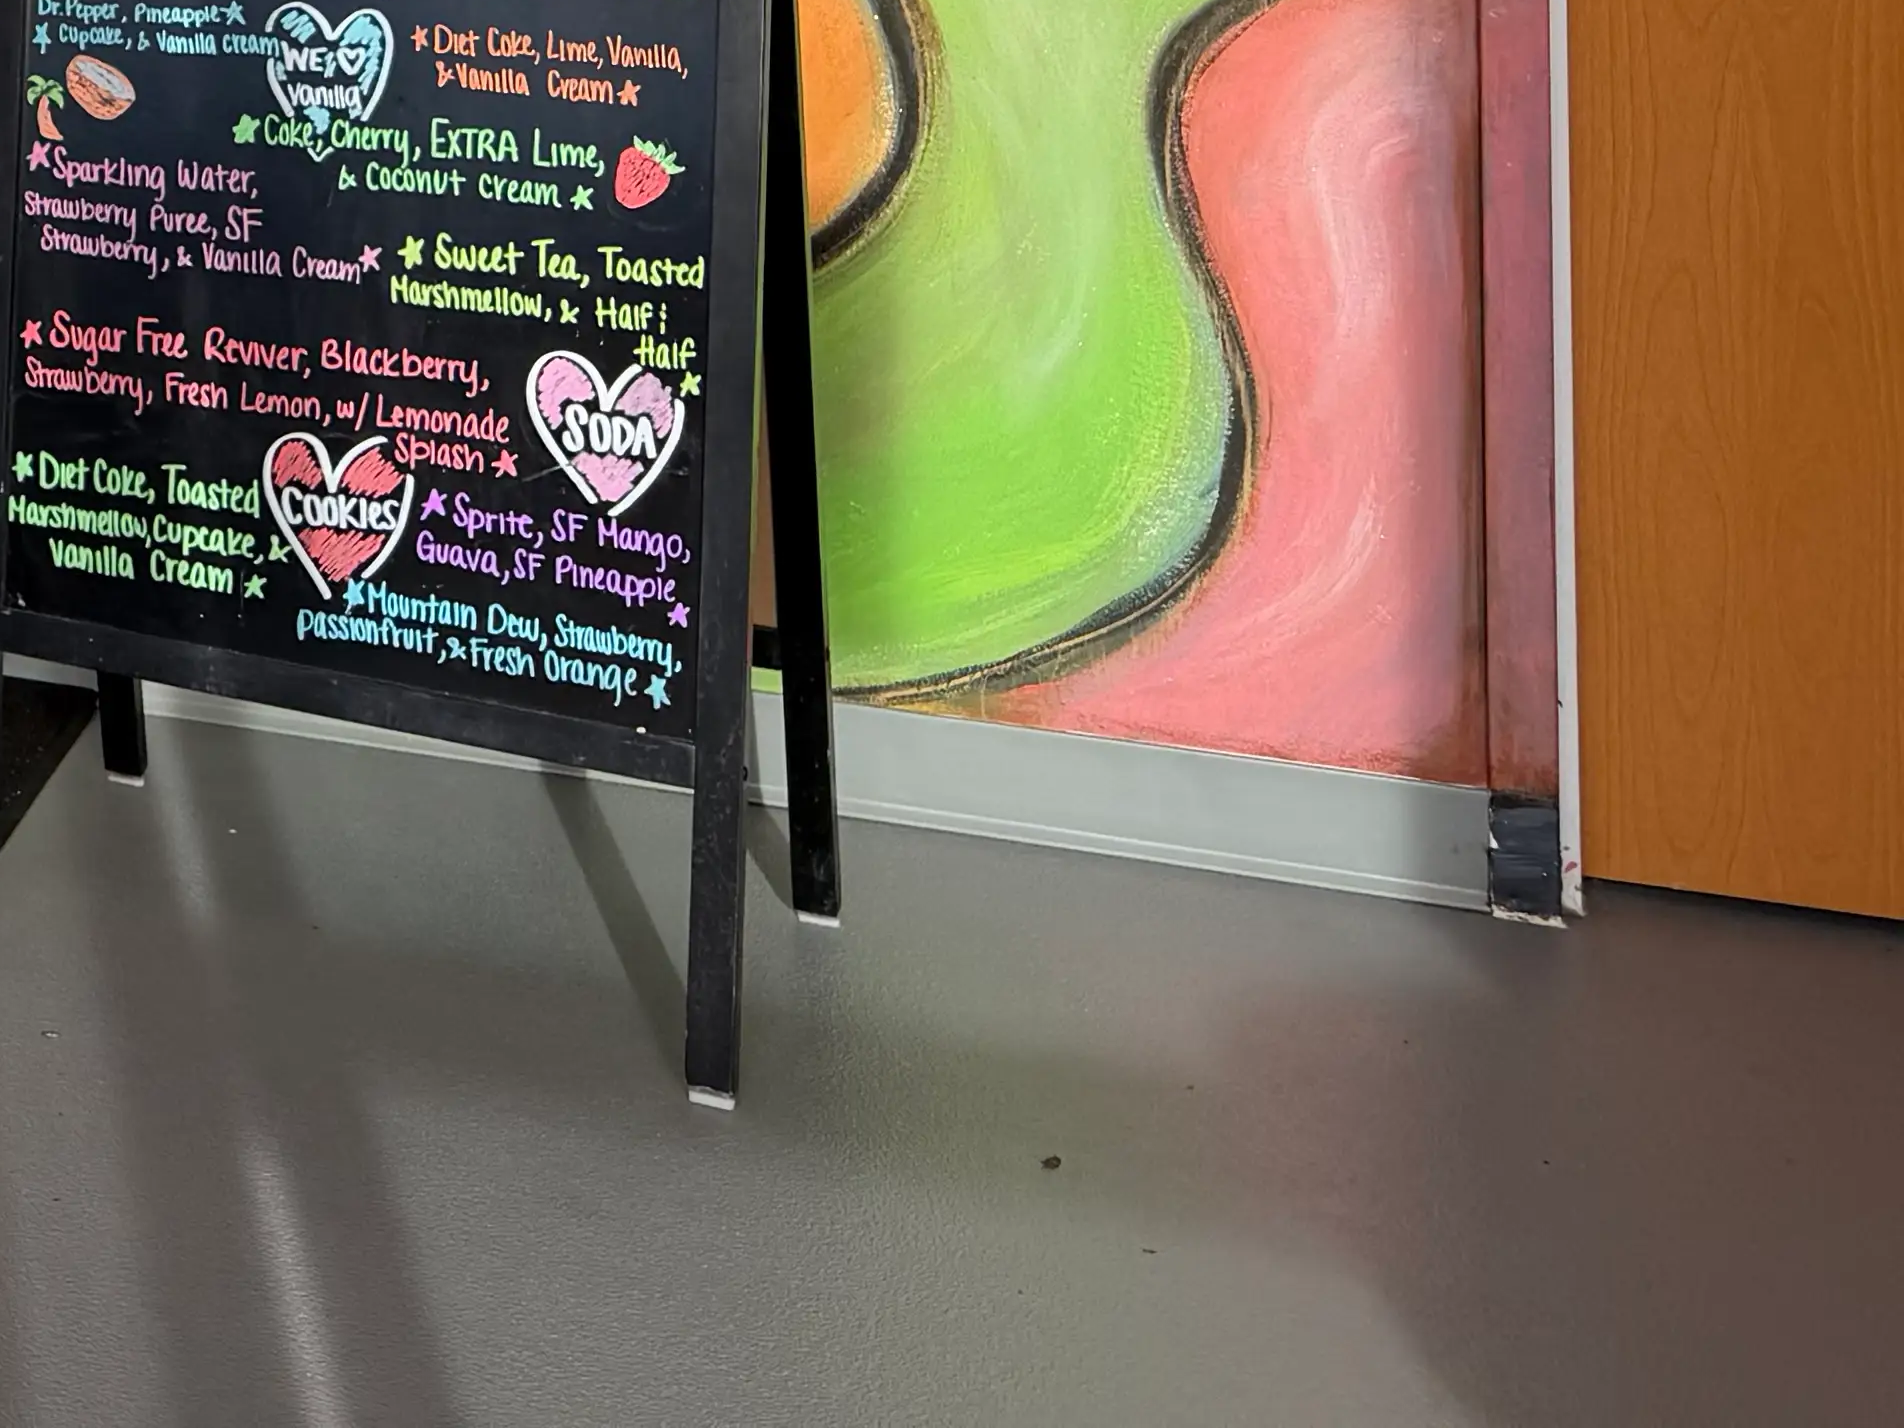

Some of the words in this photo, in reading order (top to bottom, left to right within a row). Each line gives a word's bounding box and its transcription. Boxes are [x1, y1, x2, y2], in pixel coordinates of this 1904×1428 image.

[134, 2, 220, 28] Pineapple
[138, 31, 150, 51] &
[156, 30, 217, 56] Vanilla
[434, 24, 478, 56] Diet
[487, 27, 539, 65] Coke,
[547, 30, 603, 70] Lime,
[607, 36, 688, 79] Vanilla,
[456, 64, 529, 97] Vanilla
[547, 70, 613, 105] Cream
[53, 145, 165, 202] Sparkling
[178, 158, 259, 199] Water,
[331, 116, 420, 170] Cherry,
[532, 127, 604, 178] Lime,
[339, 164, 357, 190] &
[24, 191, 137, 241] Strawberry
[149, 204, 218, 241] Puree,
[225, 205, 263, 243] SF
[40, 223, 169, 280] Strawberry,
[177, 246, 193, 267] &
[202, 243, 282, 277] Vanilla
[292, 246, 360, 284] Cream
[434, 232, 525, 275] Sweet
[531, 239, 590, 289] Tea,
[597, 246, 705, 289] Toasted
[390, 275, 552, 323] Marshmellow,
[560, 299, 579, 324] &
[595, 296, 653, 331] Half
[50, 310, 126, 367] Sugar
[136, 316, 188, 360] Free
[203, 326, 311, 380] Reviver,
[320, 338, 491, 397] Blackberry,
[633, 333, 697, 370] Half
[25, 355, 154, 416] Strawberry,
[165, 372, 229, 411] Fresh
[239, 382, 332, 428] Lemon,
[376, 393, 510, 444] Lemonade
[393, 432, 485, 474] Splash
[562, 403, 657, 459] SODA
[38, 449, 89, 491] Diet
[94, 458, 156, 505] Coke,
[161, 463, 260, 518] Toasted
[8, 494, 152, 550] Marshmellow,
[153, 517, 265, 566] Cupcake,
[268, 534, 292, 564] &
[452, 491, 545, 549] Sprite,
[551, 508, 588, 542] SF
[597, 516, 692, 573] Mango,
[49, 537, 134, 580] Vanilla
[149, 547, 234, 595] Cream
[416, 530, 511, 586] Guava,
[513, 549, 546, 581] SF
[555, 558, 676, 609] Pineapple
[367, 580, 478, 631] Mountain
[487, 602, 547, 652] Dew,
[554, 613, 683, 679] Strawberry,
[469, 637, 535, 679] Fresh
[544, 648, 637, 707] Orange
